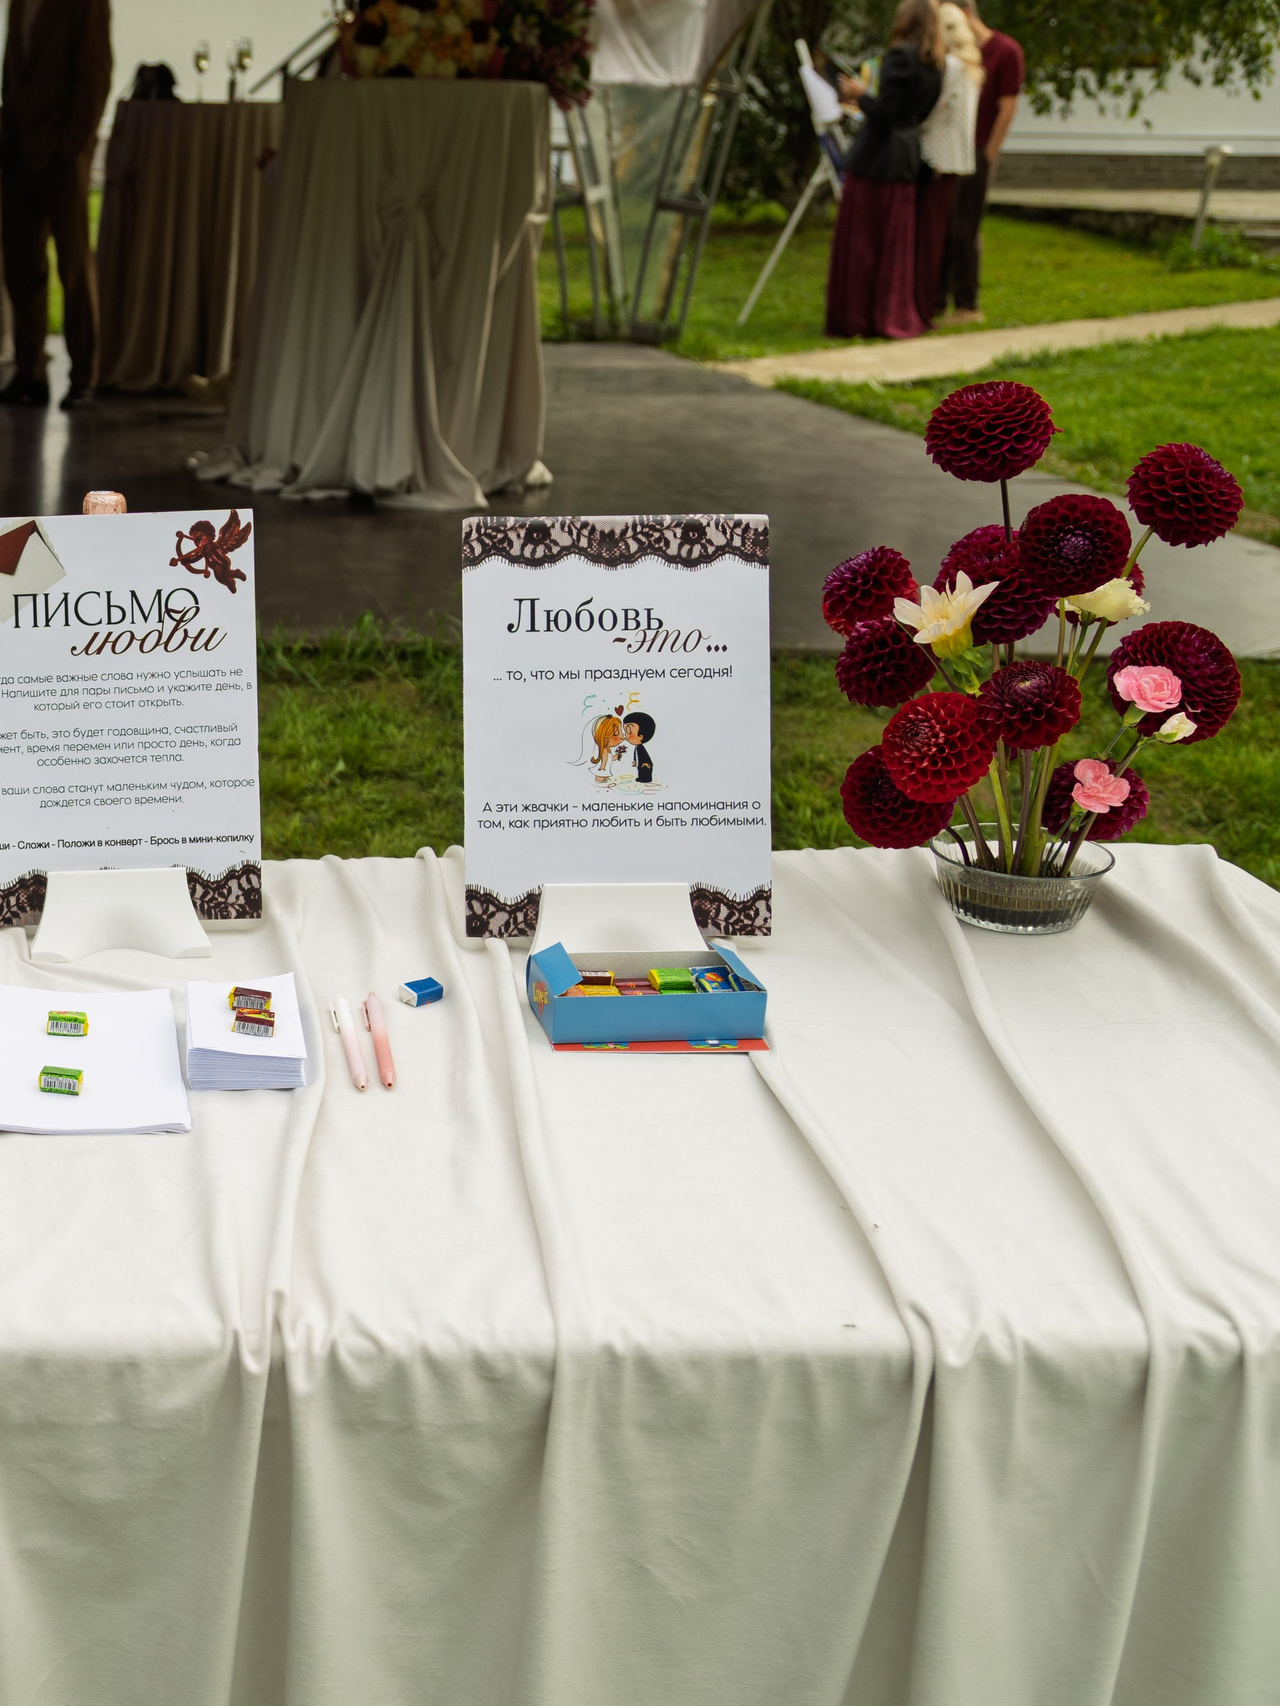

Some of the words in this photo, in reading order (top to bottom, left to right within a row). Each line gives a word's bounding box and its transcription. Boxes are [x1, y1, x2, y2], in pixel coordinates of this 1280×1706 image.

[12, 587, 200, 629] ПИСЬМО
[506, 596, 664, 633] Любовь
[70, 605, 228, 657] любви
[16, 674, 54, 685] самые
[55, 673, 99, 683] важные
[100, 671, 134, 682] слова
[136, 670, 172, 682] нужно
[173, 668, 227, 681] услышать
[229, 668, 244, 677] не
[505, 670, 527, 683] то,
[530, 669, 555, 681] что
[558, 669, 581, 680] мы
[584, 668, 666, 683] празднуем
[669, 664, 733, 680] сегодня!
[1, 688, 58, 699] Напишите
[59, 687, 80, 698] для
[81, 686, 111, 698] пары
[113, 685, 155, 695] письмо
[156, 685, 165, 693] и
[166, 683, 213, 695] укажите
[214, 682, 244, 692] день,
[246, 681, 253, 690] в
[33, 700, 81, 713] который
[82, 701, 103, 710] его
[104, 699, 136, 710] стоит
[137, 698, 185, 709] открыть.
[20, 729, 50, 741] быть,
[51, 729, 71, 739] это
[72, 727, 105, 740] будет
[107, 726, 172, 737] годовщина,
[173, 722, 238, 735] счастливый
[26, 744, 61, 755] время
[62, 742, 111, 754] перемен
[113, 741, 135, 750] или
[137, 739, 177, 751] просто
[178, 739, 208, 749] день,
[210, 737, 242, 747] когда
[36, 755, 92, 767] особенно
[93, 754, 148, 765] захочется
[149, 753, 185, 763] тепла.
[1, 787, 30, 796] ваши
[32, 785, 66, 795] слова
[67, 783, 104, 795] станут
[106, 782, 168, 792] маленьким
[169, 780, 208, 792] чудом,
[209, 778, 256, 790] которое
[38, 798, 92, 809] дождется
[93, 796, 133, 807] своего
[134, 795, 185, 807] времени.
[482, 801, 493, 813] А
[495, 803, 518, 813] эти
[520, 802, 569, 813] жвачки
[581, 801, 654, 812] маленькие
[657, 800, 749, 811] напоминания
[751, 800, 762, 810] о
[476, 819, 506, 831] том,
[508, 819, 531, 829] как
[533, 818, 589, 831] приятно
[591, 815, 641, 828] любить
[643, 818, 653, 827] и
[655, 814, 688, 827] быть
[690, 814, 767, 827] любимыми.
[16, 840, 51, 850] Сложи
[57, 838, 96, 849] Положи
[96, 839, 104, 848] в
[104, 838, 144, 848] конверт
[149, 835, 181, 847] Брось
[180, 836, 188, 845] в
[188, 834, 255, 844] мини-копилку
